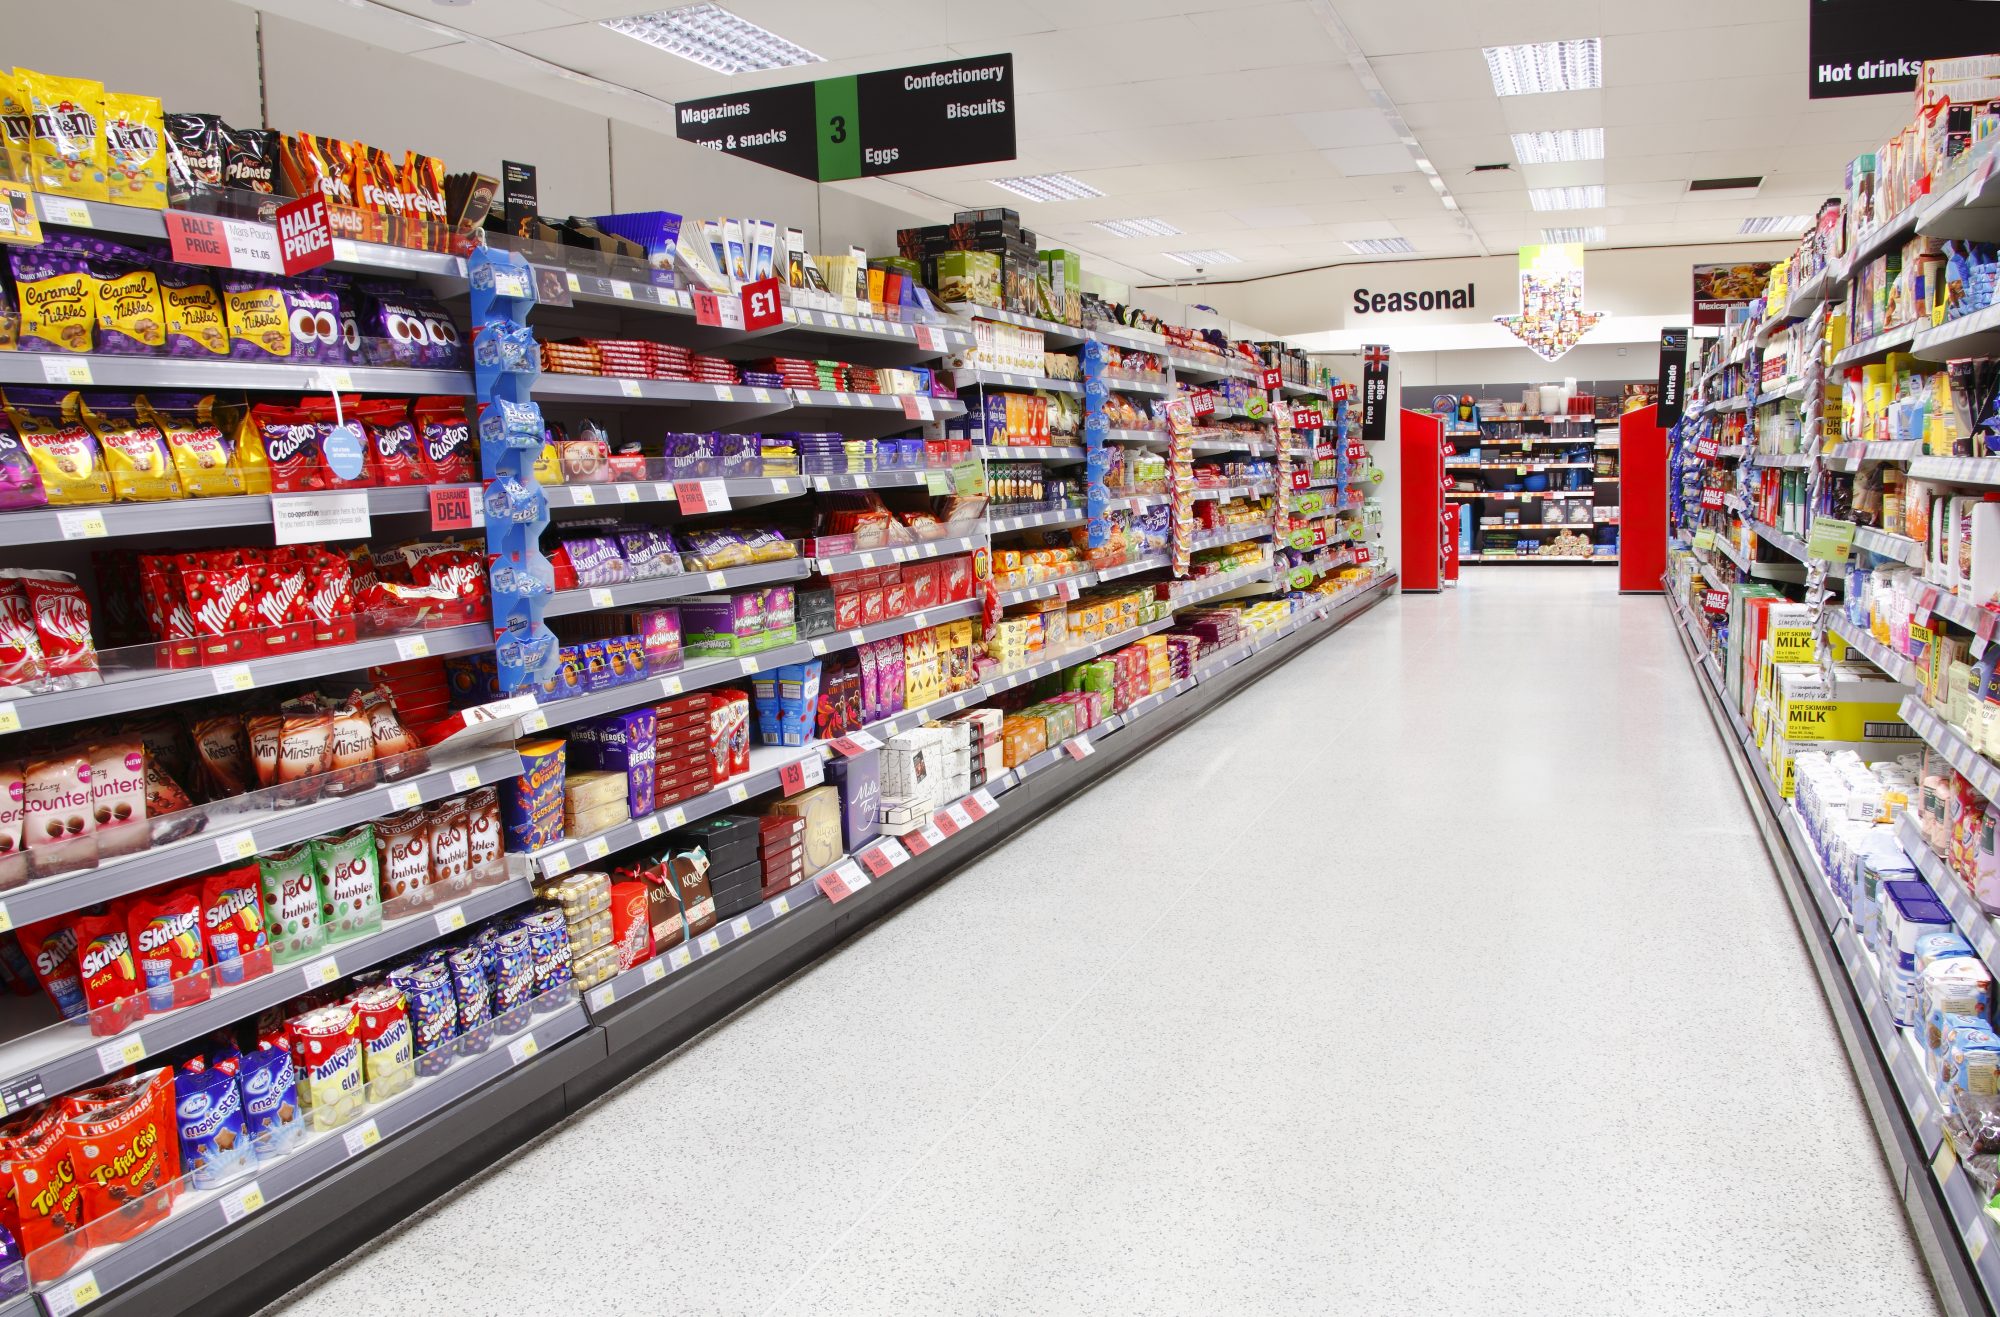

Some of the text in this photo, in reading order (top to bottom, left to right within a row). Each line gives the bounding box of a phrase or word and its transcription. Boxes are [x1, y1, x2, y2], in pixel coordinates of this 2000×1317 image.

[904, 65, 1004, 91] Confectionery
[1818, 58, 1921, 83] Hot drinks
[681, 102, 750, 124] Magazines
[947, 98, 1005, 120] Biscuits
[727, 128, 787, 150] & snacks
[830, 115, 847, 144] 3
[865, 147, 899, 165] Eggs
[182, 217, 216, 236] HALF
[280, 202, 325, 240] HALF
[229, 225, 274, 242] Mars Pouch
[185, 237, 221, 255] PRICE
[285, 227, 330, 261] PRICE
[250, 249, 271, 260] £1.05
[26, 279, 89, 306] Caramel
[99, 275, 154, 301] Caramel
[168, 289, 217, 308] Caramel
[230, 294, 281, 314] Caramel
[291, 299, 333, 311] buttons
[701, 295, 714, 315] £1
[751, 288, 776, 319] £1
[1353, 282, 1475, 315] Seasonal
[1698, 302, 1728, 311] Mexican
[38, 306, 87, 327] Nibbles
[113, 300, 154, 320] Nibbles
[182, 308, 218, 325] Nibbles
[385, 303, 417, 317] buttons
[242, 313, 282, 329] Nibbles
[1267, 372, 1279, 385] £1
[1665, 364, 1677, 406] Fairtrade
[1334, 387, 1346, 398] £1
[1376, 379, 1386, 400] eggs
[1366, 379, 1377, 425] Free range
[1297, 412, 1309, 424] £1
[1310, 414, 1320, 425] £1
[28, 425, 89, 448] Crunchie
[104, 426, 162, 448] Crunchie
[172, 426, 223, 446] Crunchie
[269, 423, 316, 462] Clusters
[429, 424, 469, 462] Clusters
[1699, 439, 1719, 450] HALF
[675, 447, 713, 468] DAIRY MILK
[1348, 446, 1358, 456] £1
[1295, 474, 1307, 485] £1
[436, 491, 467, 501] CLEARANCE
[1702, 495, 1723, 506] PRICE
[1703, 488, 1724, 499] HALF
[287, 508, 319, 519] co-operative
[438, 501, 471, 522] DEAL
[574, 545, 620, 571] DAIRY MILK
[630, 542, 671, 564] DAIRY MILK
[1358, 550, 1368, 560] £1
[1705, 599, 1727, 611] PRICE
[1706, 592, 1729, 602] HALF
[1776, 637, 1811, 649] MILK
[1911, 626, 1930, 642] ATORA
[688, 697, 706, 708] premium
[1805, 704, 1838, 712] SKIMMED
[689, 712, 707, 723] premium
[1789, 710, 1827, 723] MILK
[600, 733, 628, 744] HEROES
[126, 758, 142, 767] NEW
[630, 749, 656, 768] HEROES
[787, 763, 800, 784] £3
[852, 776, 879, 804] Milk
[436, 827, 461, 852] Aero
[392, 837, 424, 865] Aero
[335, 857, 367, 888] Aero
[282, 873, 312, 902] Aero
[334, 882, 373, 901] bubbles
[206, 883, 259, 929] Skittles
[282, 899, 319, 920] bubbles
[138, 905, 200, 952] Skittles
[210, 932, 239, 945] Blue
[82, 931, 129, 979] Skittle
[142, 958, 172, 970] Blue
[535, 944, 573, 981] Smarties
[91, 973, 113, 992] Fruits
[504, 964, 535, 1005] Smarties
[251, 1084, 280, 1113] magic
[106, 1089, 153, 1130] TO SHARE
[185, 1110, 221, 1138] magic
[90, 1122, 158, 1187] Toffee Crisp
[130, 1151, 158, 1187] Clusters
